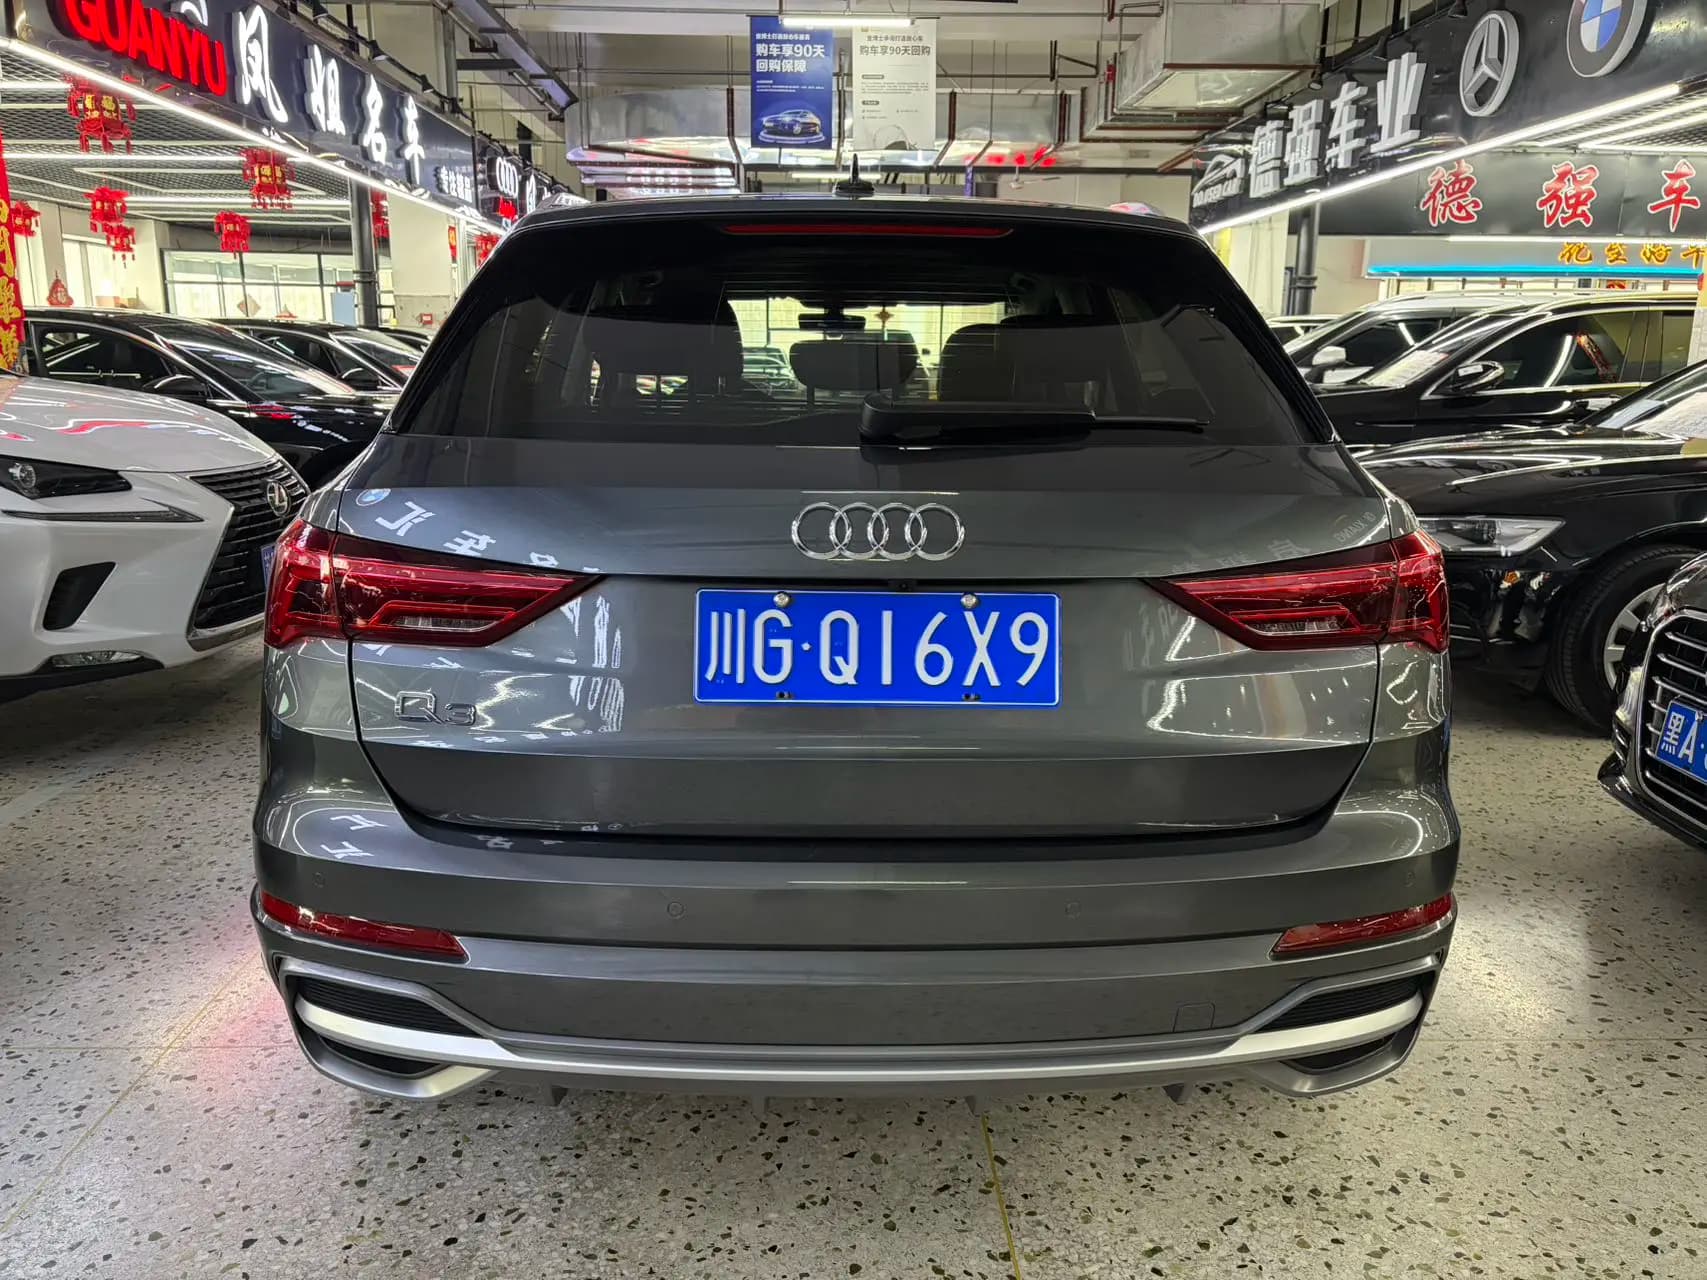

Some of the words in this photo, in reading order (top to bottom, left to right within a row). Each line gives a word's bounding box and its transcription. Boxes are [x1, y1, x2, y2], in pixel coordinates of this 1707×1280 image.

[63, 0, 228, 97] GUANYU
[756, 43, 825, 58] 购车享90天
[756, 59, 808, 73] 回购保障
[859, 44, 932, 57] 购车享90天回购
[1248, 51, 1427, 199] 德强车业
[1419, 159, 1702, 232] 德强车
[705, 608, 1050, 688] 川G·Q16X9
[394, 689, 477, 726] Q3
[1661, 711, 1707, 770] 黑A·
